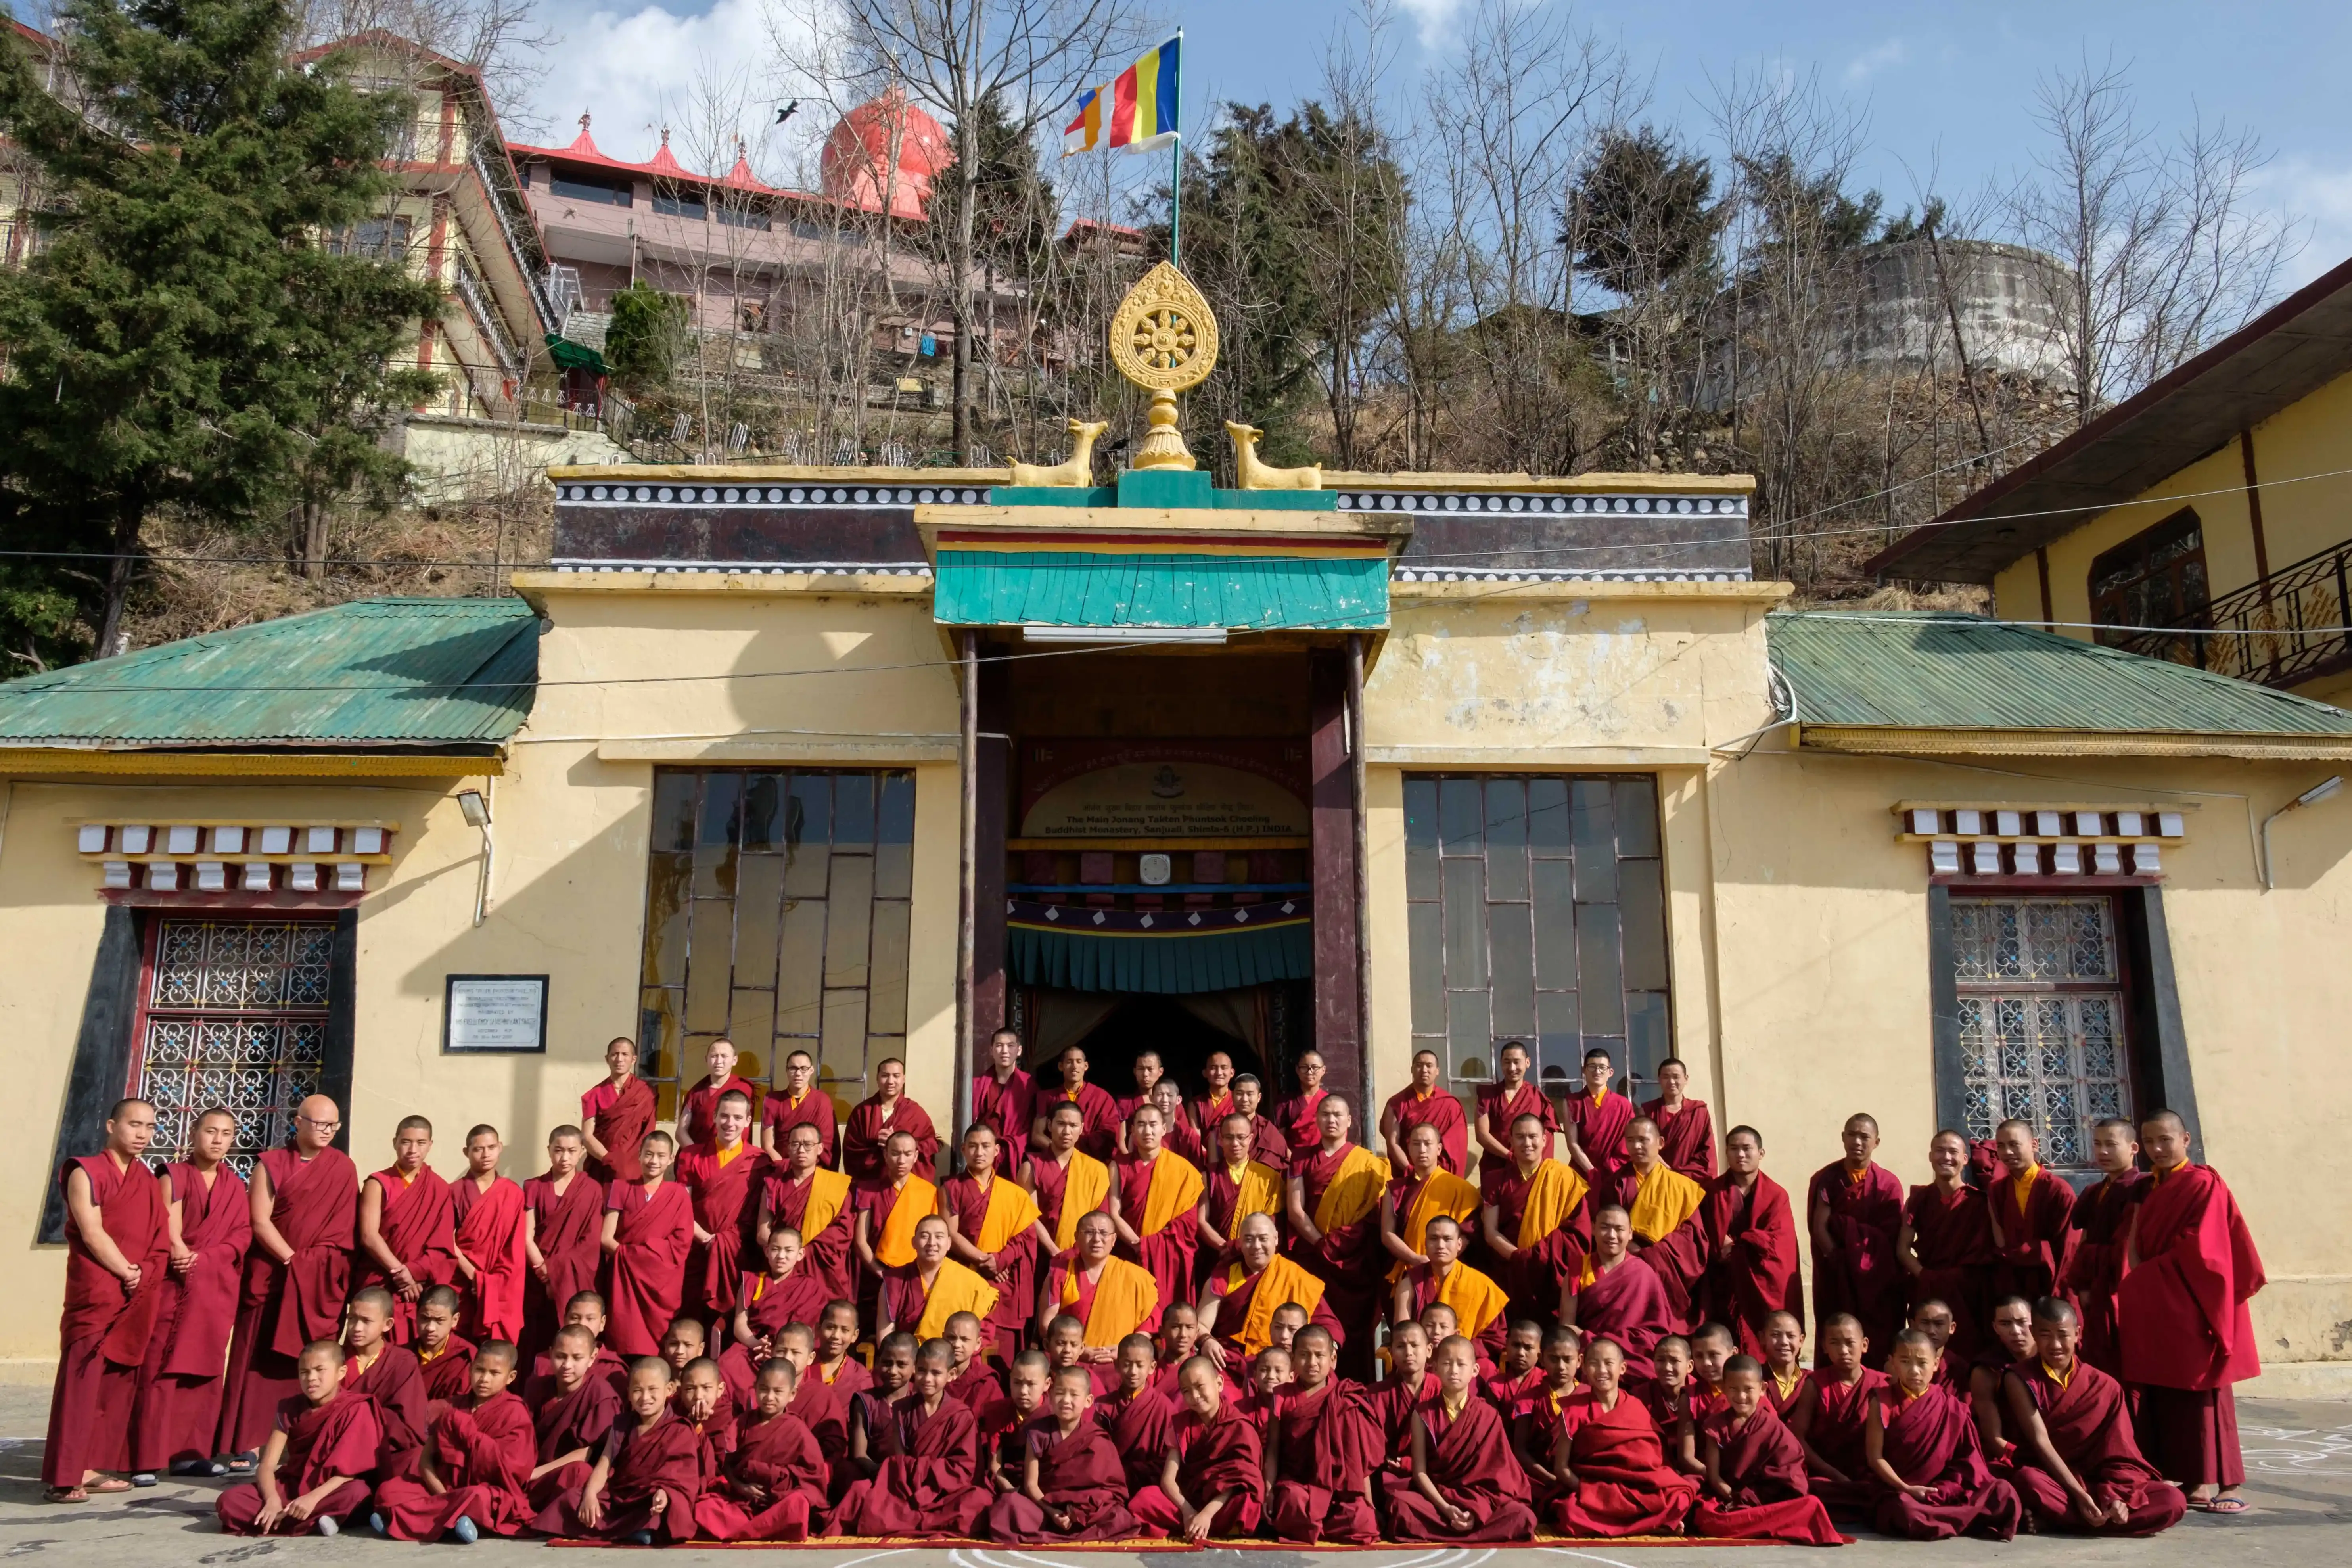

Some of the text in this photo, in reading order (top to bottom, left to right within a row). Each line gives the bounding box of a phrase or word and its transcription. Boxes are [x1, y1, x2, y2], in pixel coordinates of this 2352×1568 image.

[1112, 816, 1145, 824] Jonang
[1230, 815, 1270, 824] Choeling
[1089, 826, 1141, 835] Monastery,
